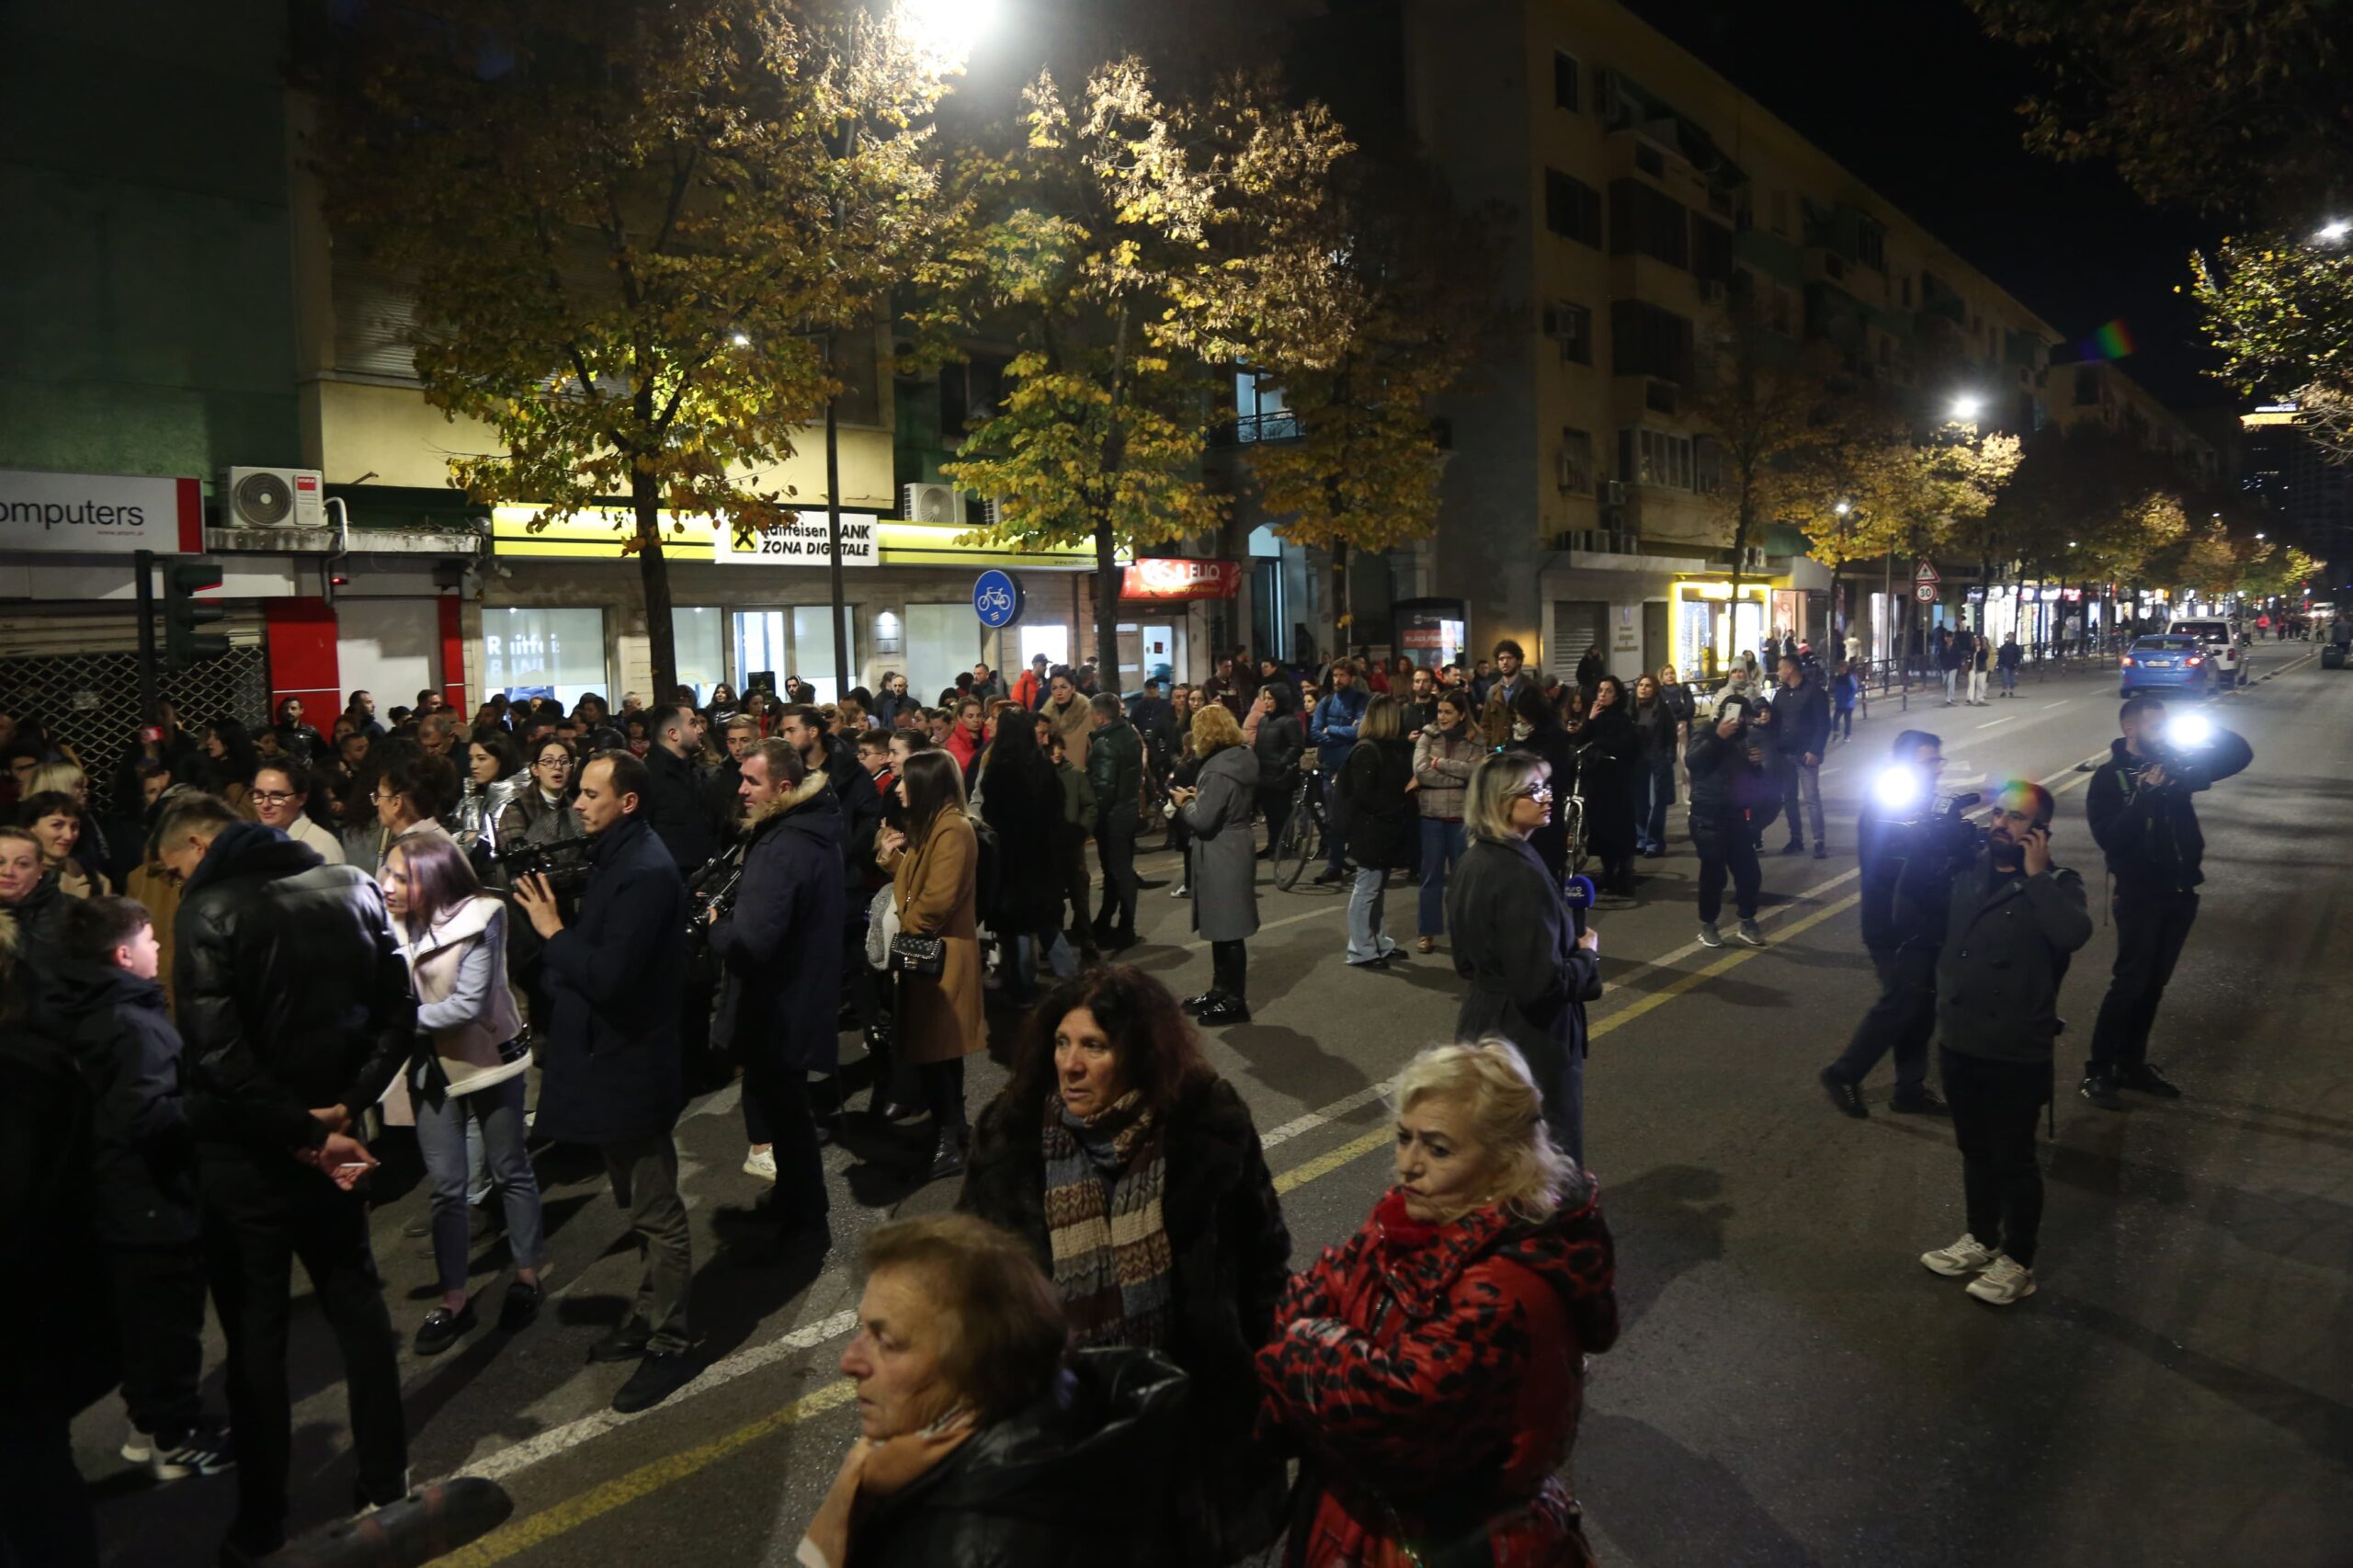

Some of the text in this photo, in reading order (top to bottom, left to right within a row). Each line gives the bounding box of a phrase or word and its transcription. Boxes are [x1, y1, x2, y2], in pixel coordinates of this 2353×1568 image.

[840, 524, 870, 540] ANK
[762, 540, 870, 557] ZONA DIGTALE
[1920, 588, 1932, 597] 30
